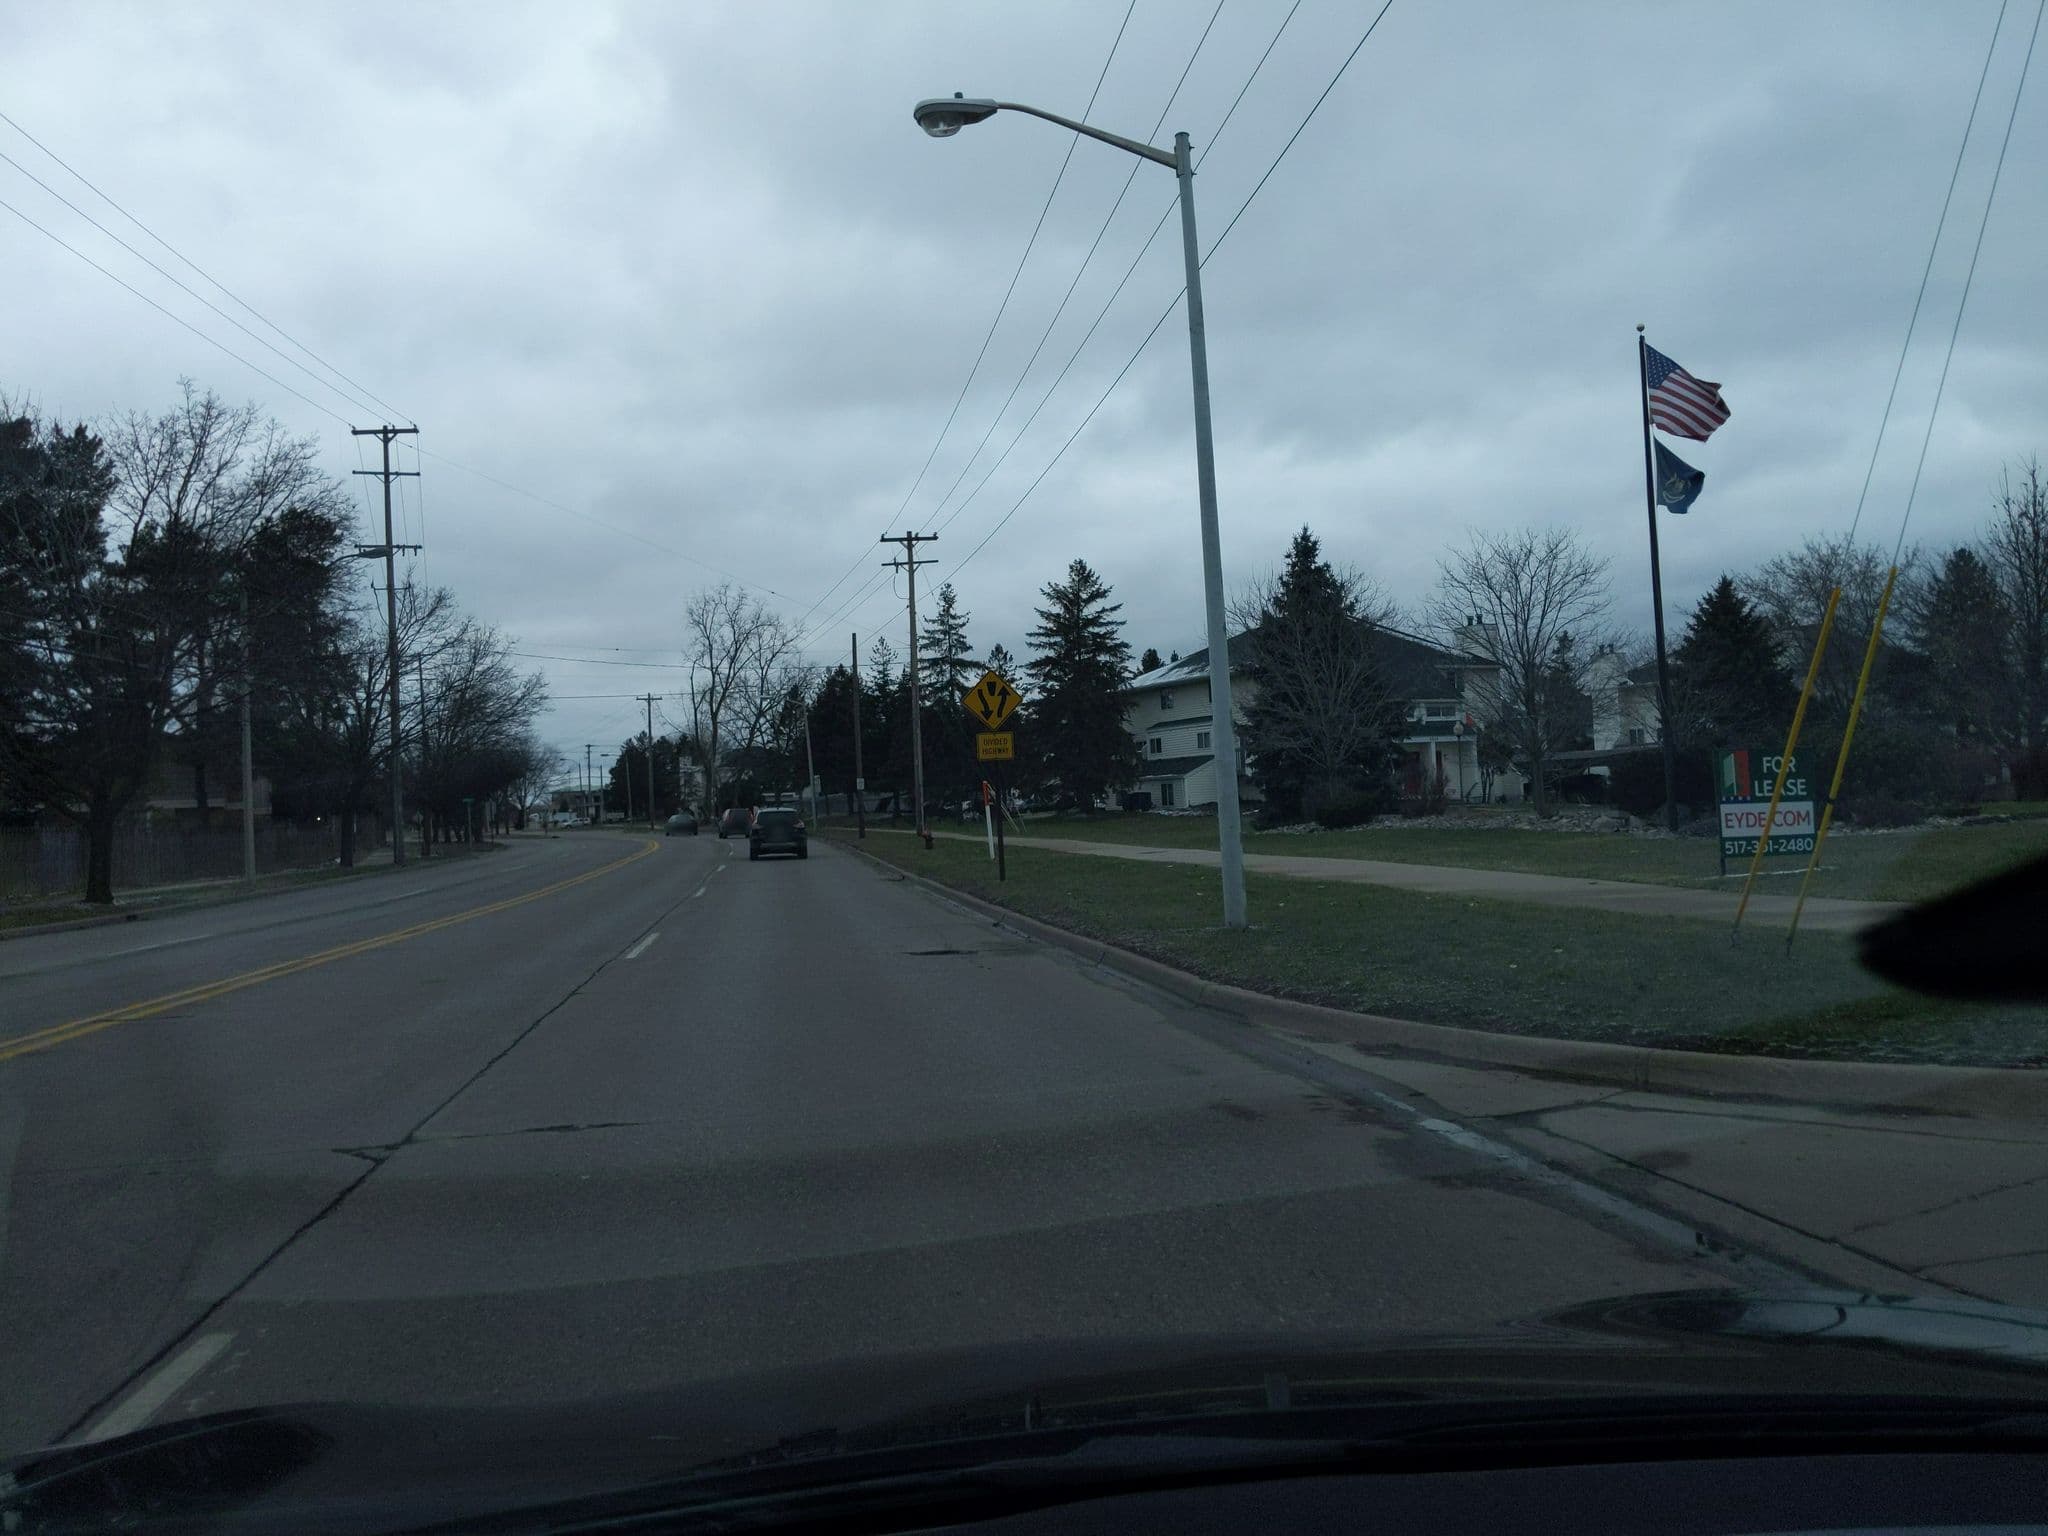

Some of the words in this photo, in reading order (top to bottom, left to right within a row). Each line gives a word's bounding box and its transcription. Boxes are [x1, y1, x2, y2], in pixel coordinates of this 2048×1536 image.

[983, 737, 1008, 746] DIVIDED
[1762, 756, 1796, 773] FOR
[1724, 811, 1811, 828] EYDECOM
